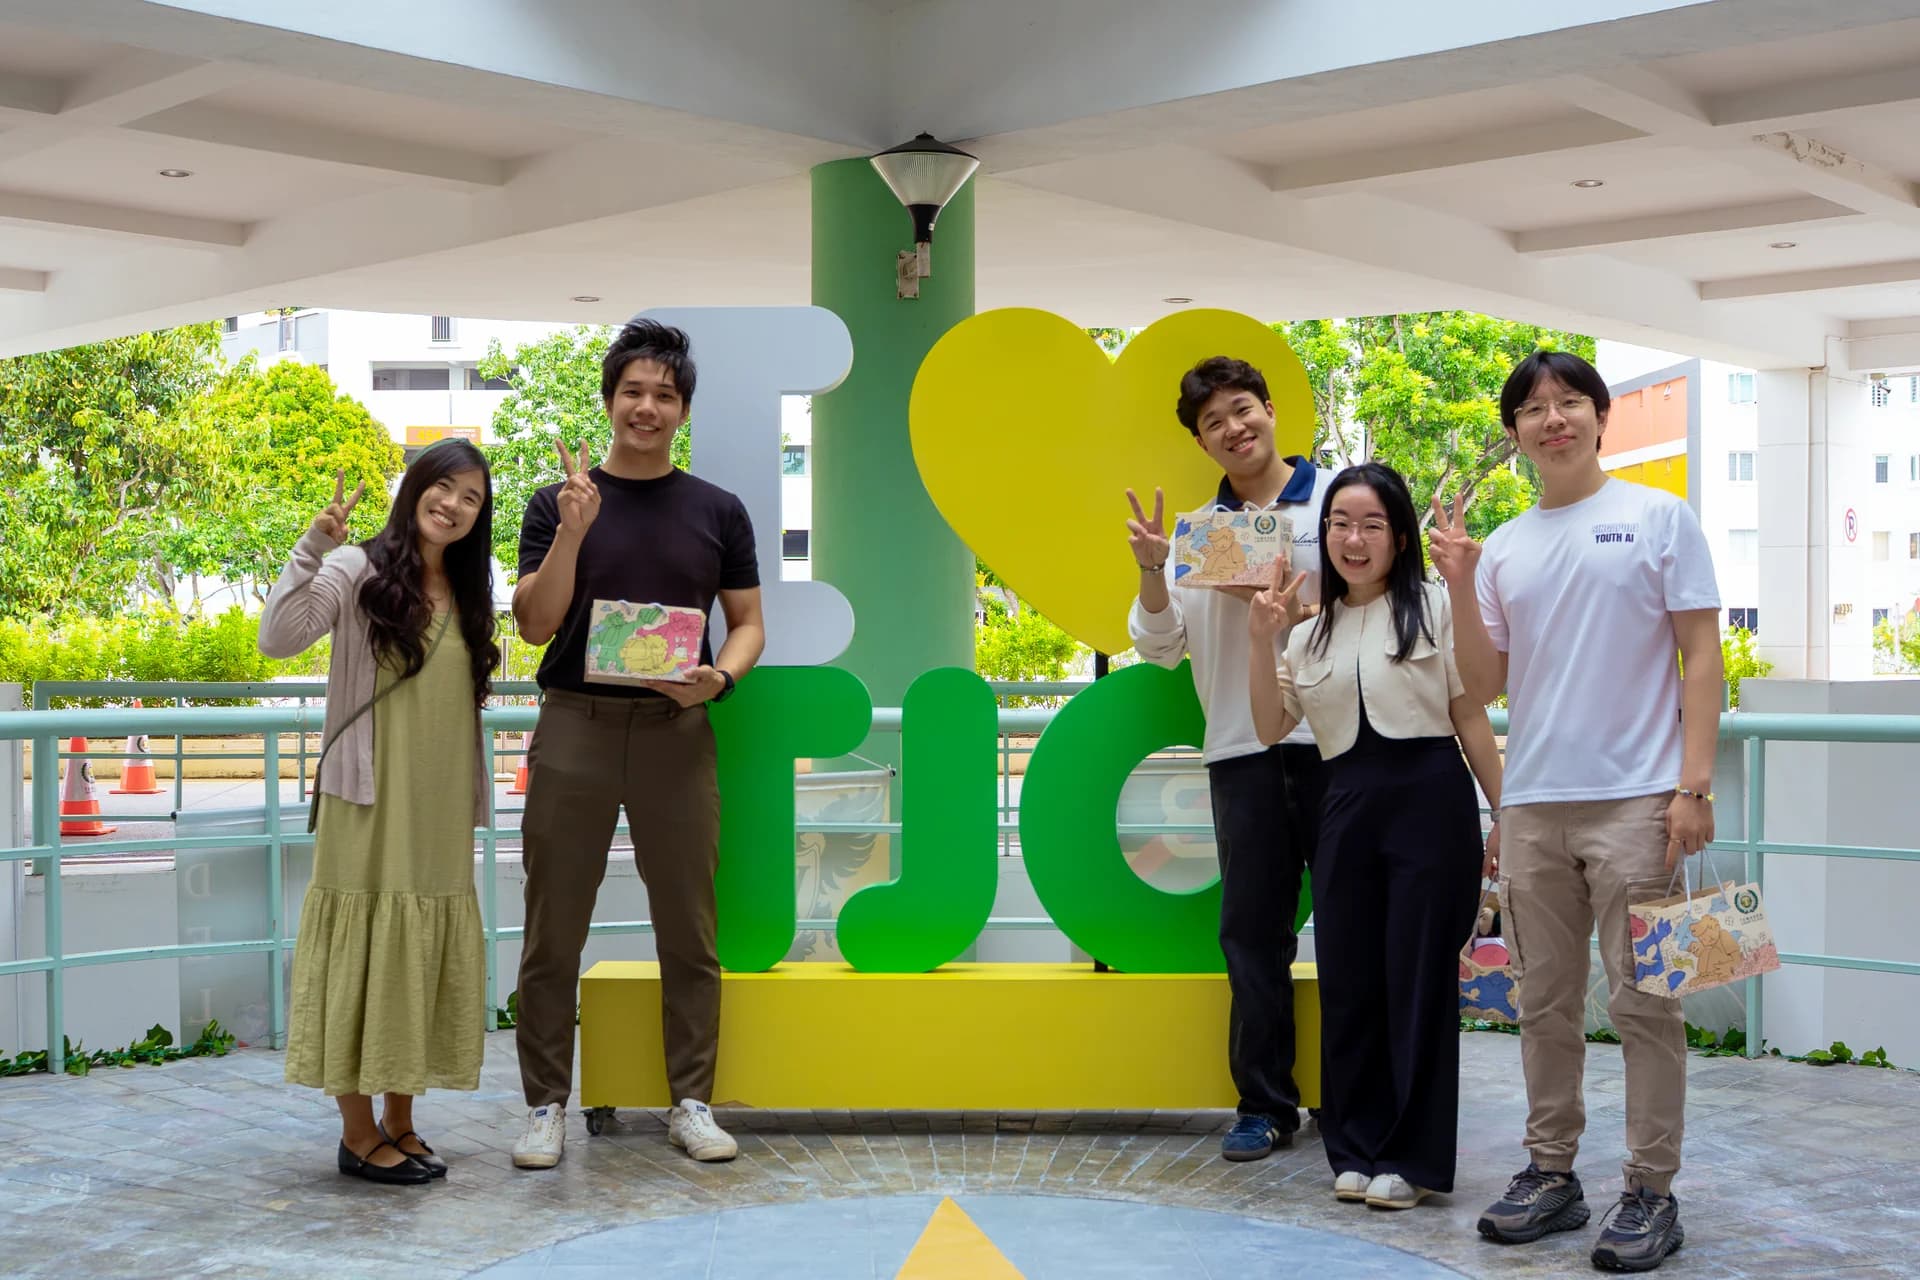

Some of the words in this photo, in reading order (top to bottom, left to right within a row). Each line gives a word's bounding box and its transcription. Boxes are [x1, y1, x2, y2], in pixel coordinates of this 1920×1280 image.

[637, 306, 854, 665] I
[1595, 533, 1622, 544] YOUTH
[1625, 533, 1634, 542] AI
